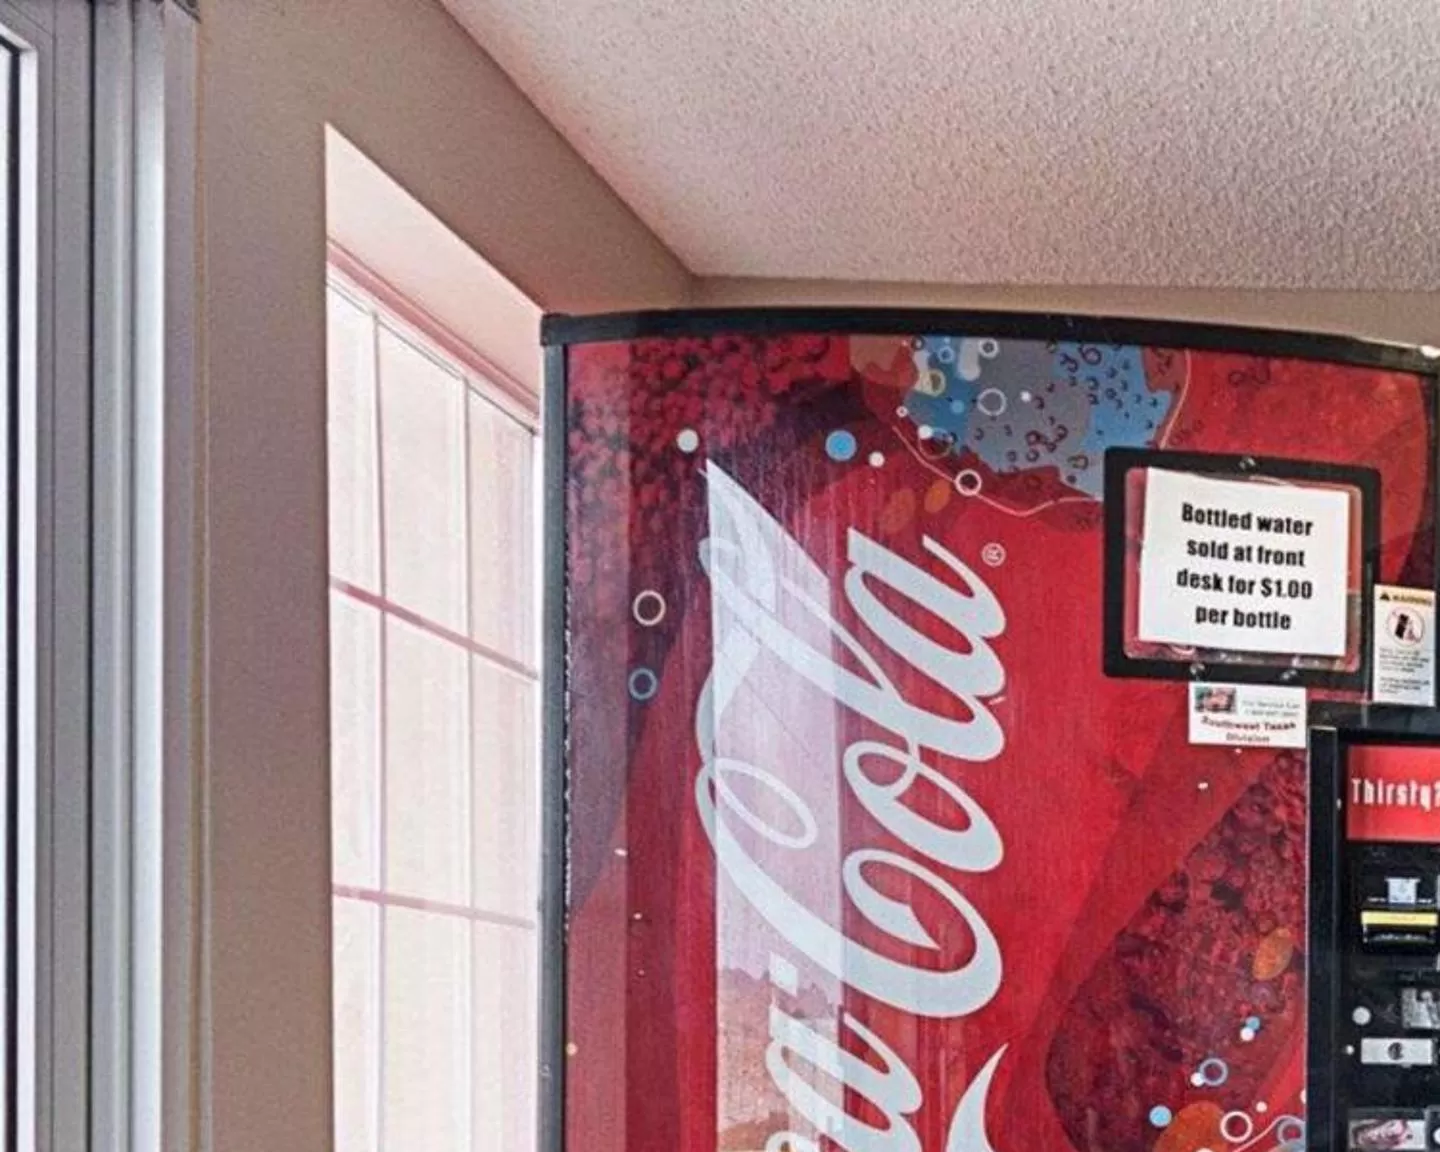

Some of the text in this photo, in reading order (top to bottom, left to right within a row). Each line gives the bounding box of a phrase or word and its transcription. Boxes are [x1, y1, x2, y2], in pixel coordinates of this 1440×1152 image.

[1182, 503, 1313, 536] Bottled water
[1187, 539, 1305, 567] sold at front
[1177, 569, 1313, 600] desk for $1.00
[1196, 606, 1292, 630] per bottle
